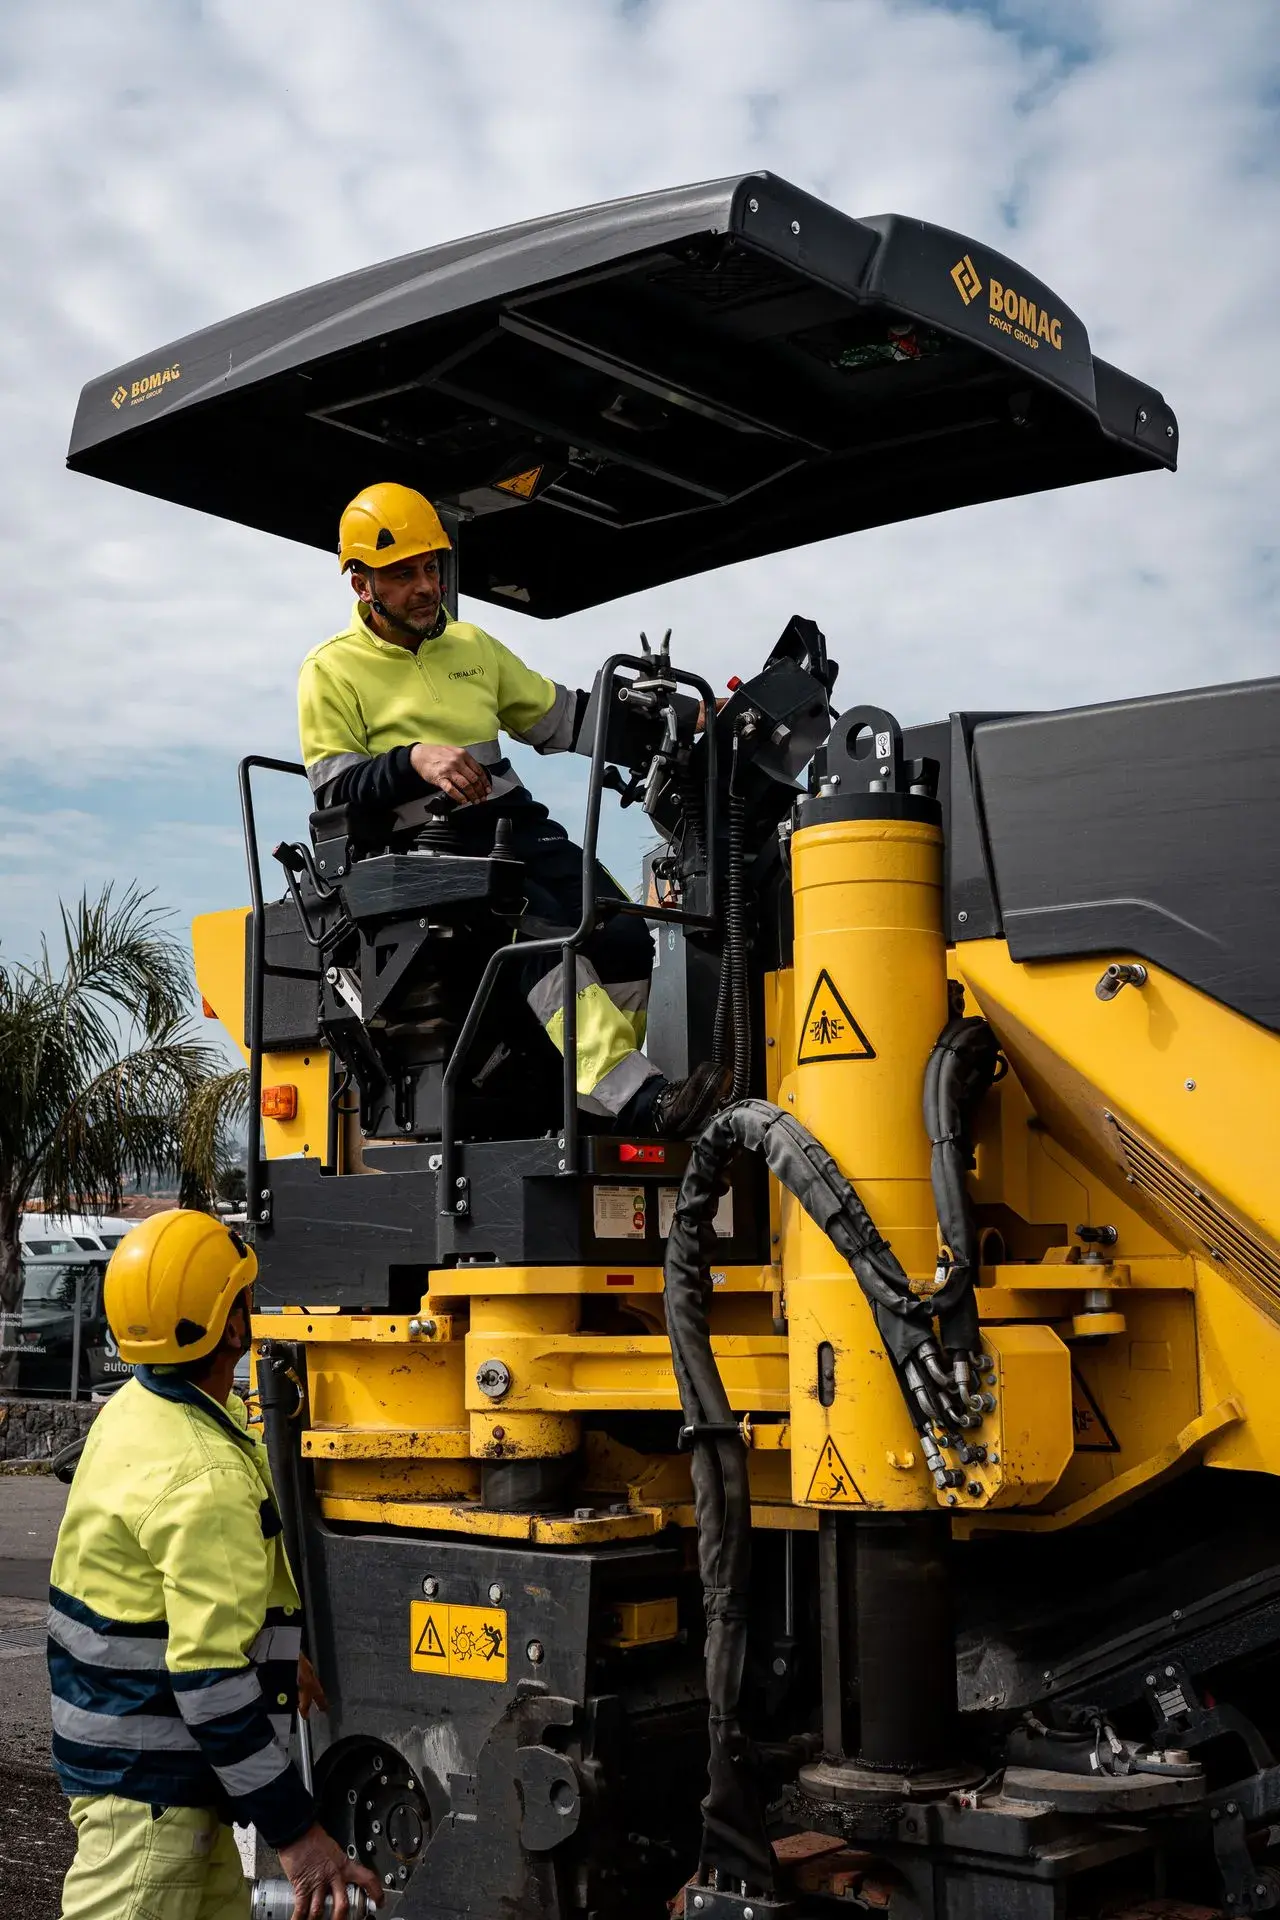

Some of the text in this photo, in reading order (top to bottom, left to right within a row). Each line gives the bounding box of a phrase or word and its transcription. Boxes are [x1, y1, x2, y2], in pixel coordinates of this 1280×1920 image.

[989, 278, 1062, 350] BOMAG
[989, 313, 1039, 349] FAYAT GROUP
[131, 363, 181, 398] BOMAG
[104, 1329, 120, 1358] S
